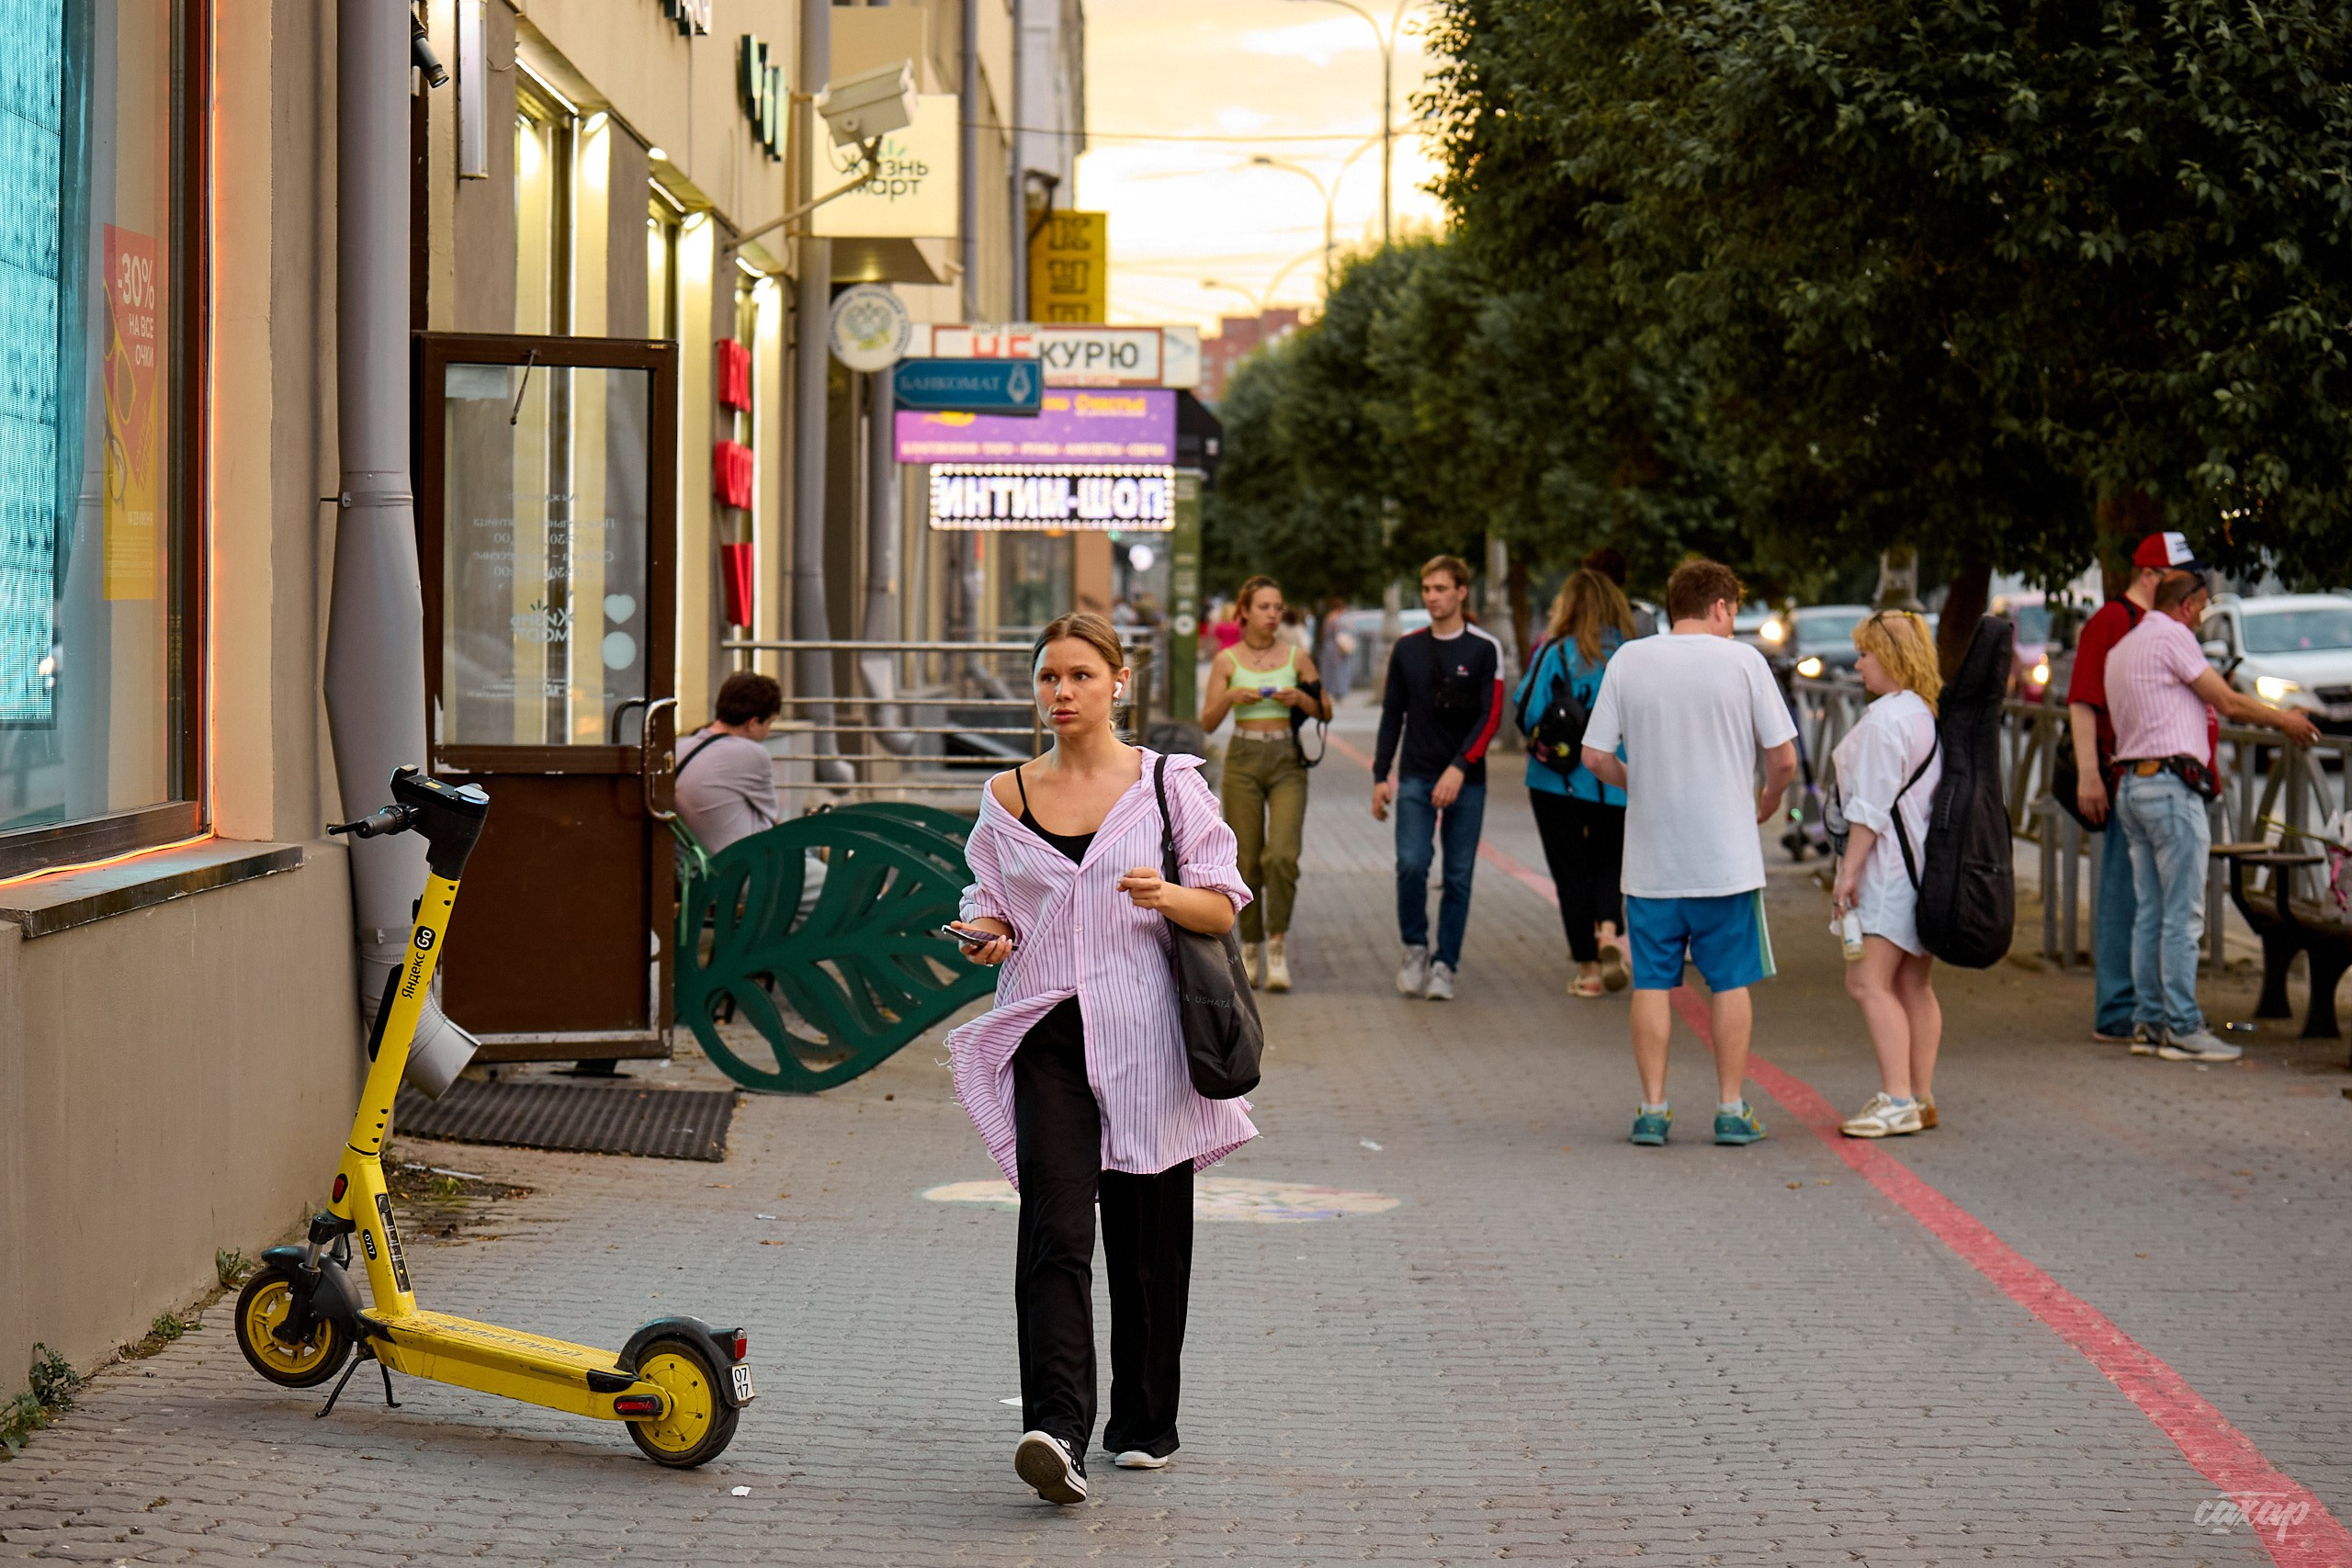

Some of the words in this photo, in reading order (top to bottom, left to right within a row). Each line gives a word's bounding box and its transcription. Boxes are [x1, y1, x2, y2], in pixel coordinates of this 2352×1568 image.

[118, 252, 155, 310] -30%
[129, 313, 139, 336] НА
[141, 315, 154, 340] ВСЕ
[135, 344, 154, 368] ОЧКИ
[899, 376, 1000, 391] БАНКОМАТ
[937, 476, 1166, 519] ИНТИМ-ШОП
[401, 951, 425, 999] Яндекс
[416, 929, 433, 948] Go
[364, 1234, 376, 1255] 0717
[734, 1367, 747, 1382] 07
[738, 1383, 749, 1398] 17
